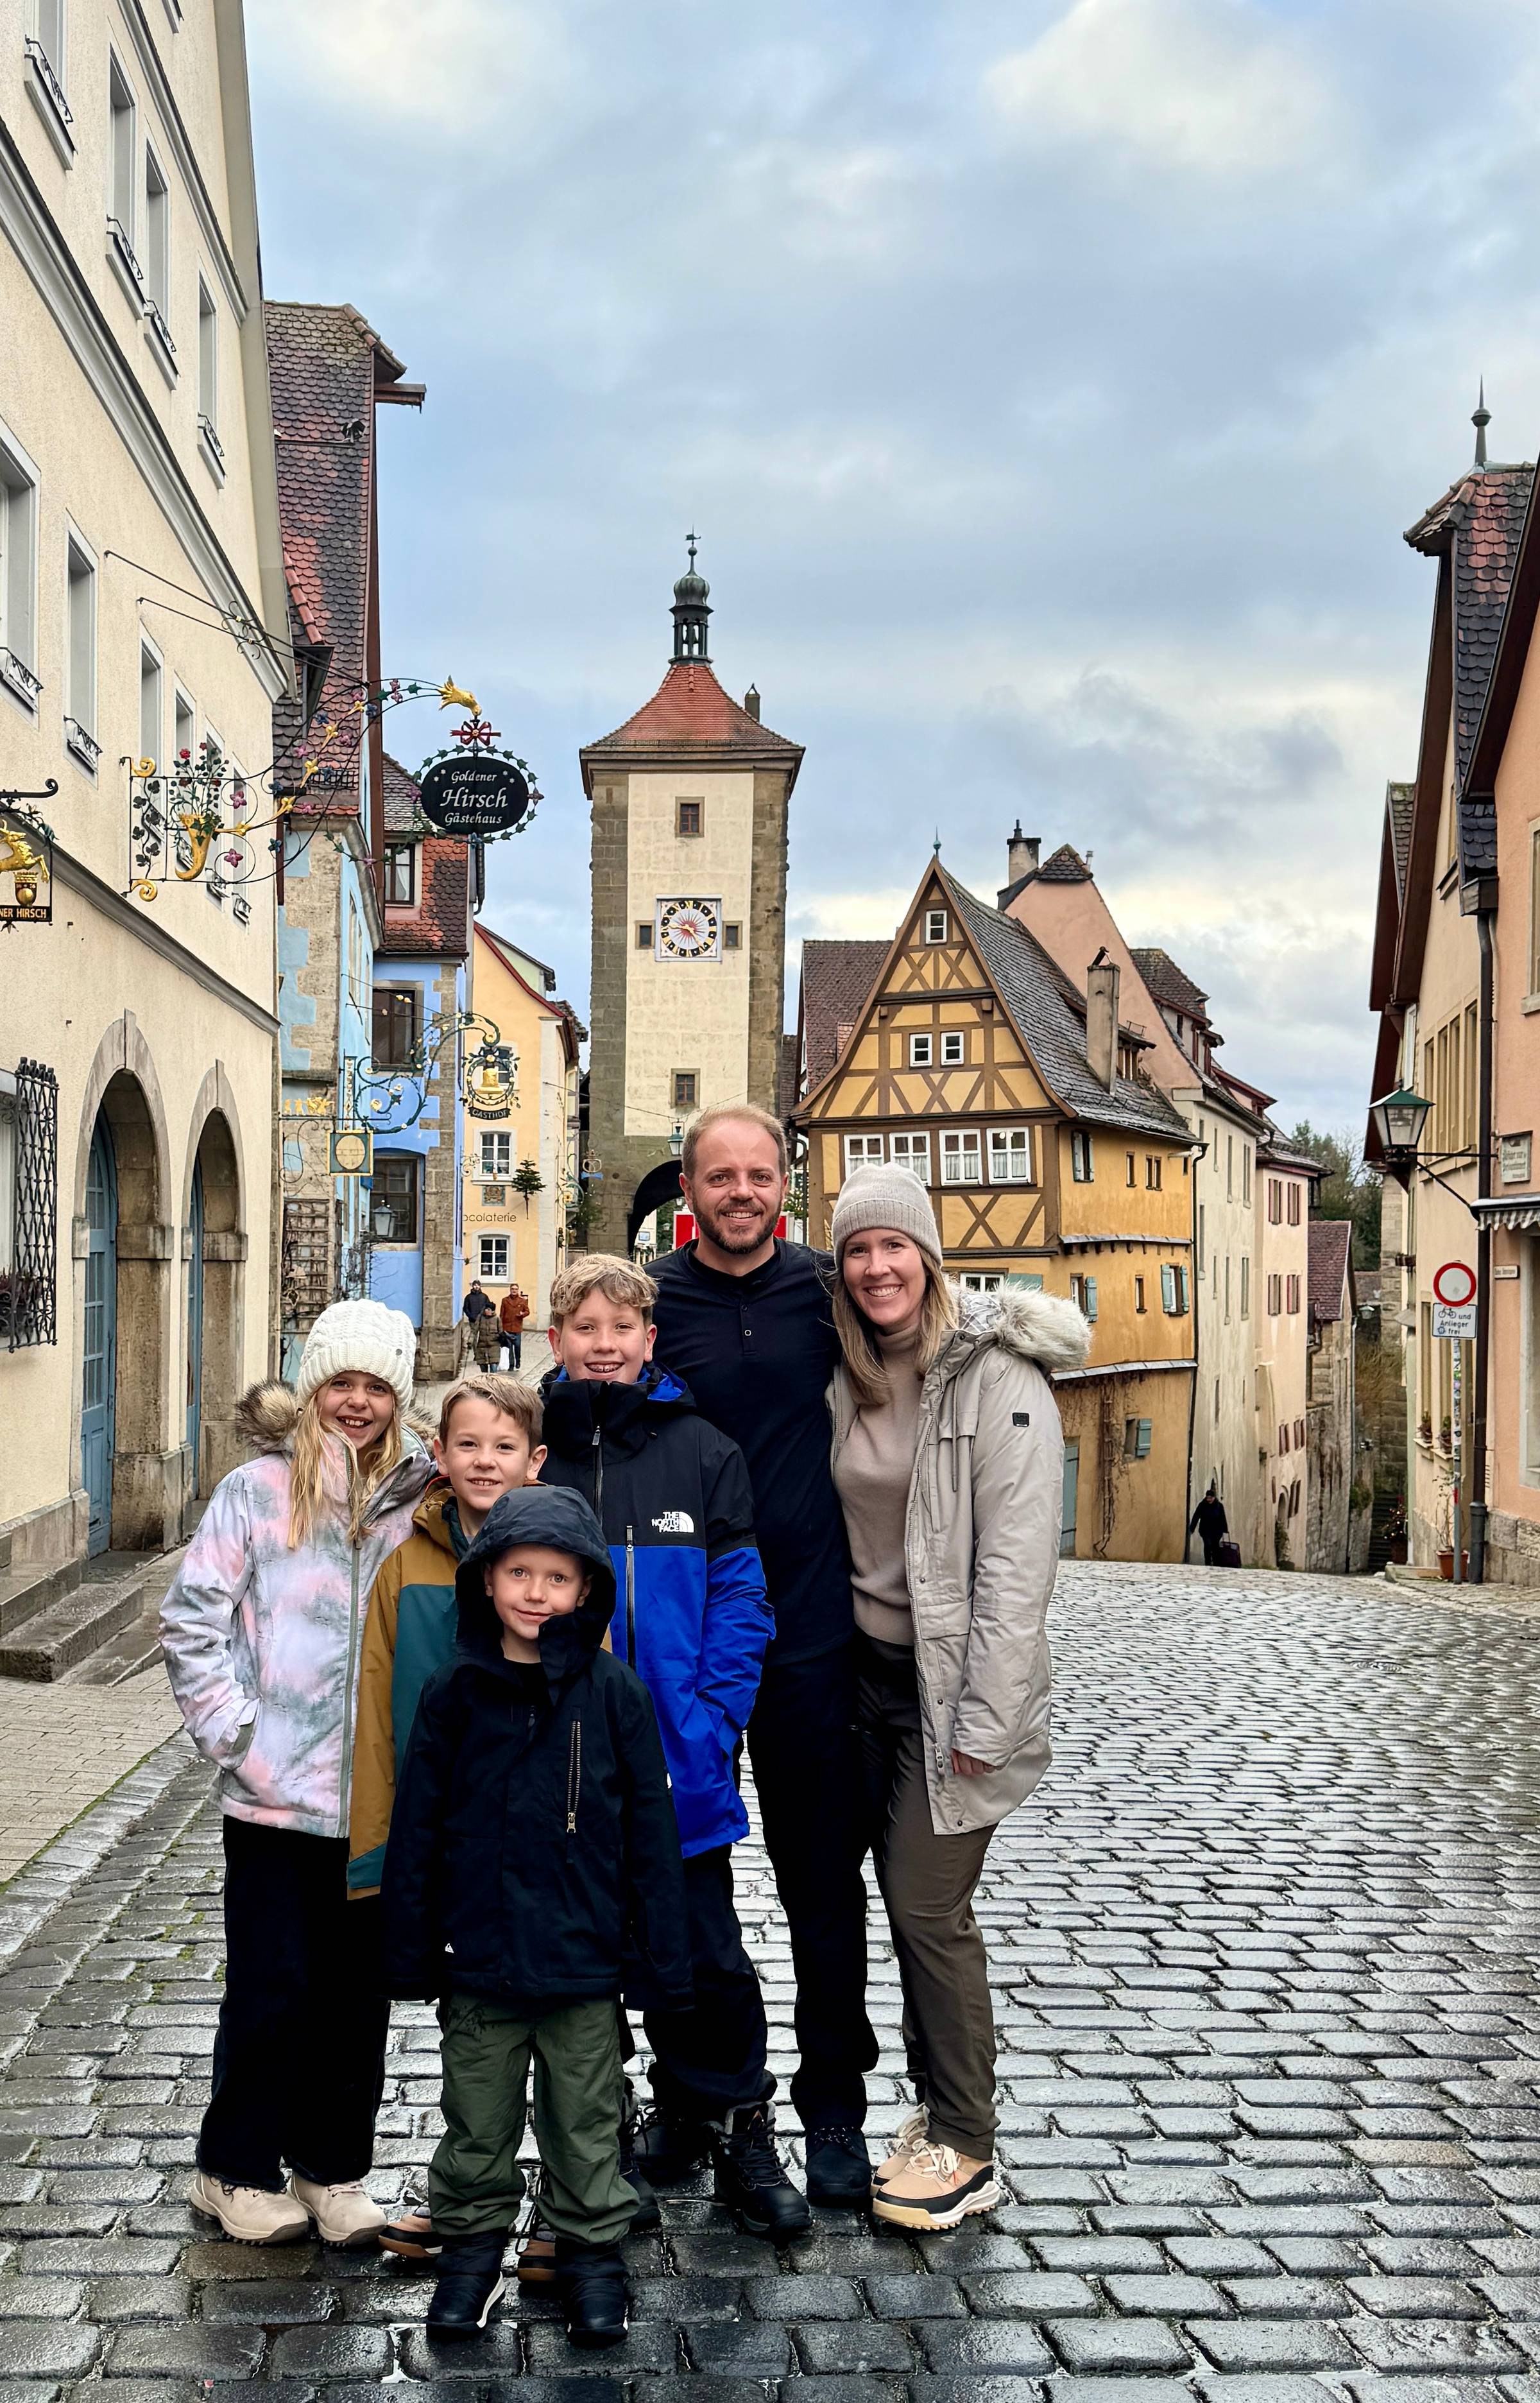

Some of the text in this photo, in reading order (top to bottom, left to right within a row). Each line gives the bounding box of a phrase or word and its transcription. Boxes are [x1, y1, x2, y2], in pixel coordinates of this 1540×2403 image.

[451, 770, 497, 784] Goldener
[440, 787, 508, 808] Hirsch
[445, 812, 502, 826] Gästehaus
[17, 908, 46, 918] HIRSCH
[472, 1109, 507, 1119] GASTHOF
